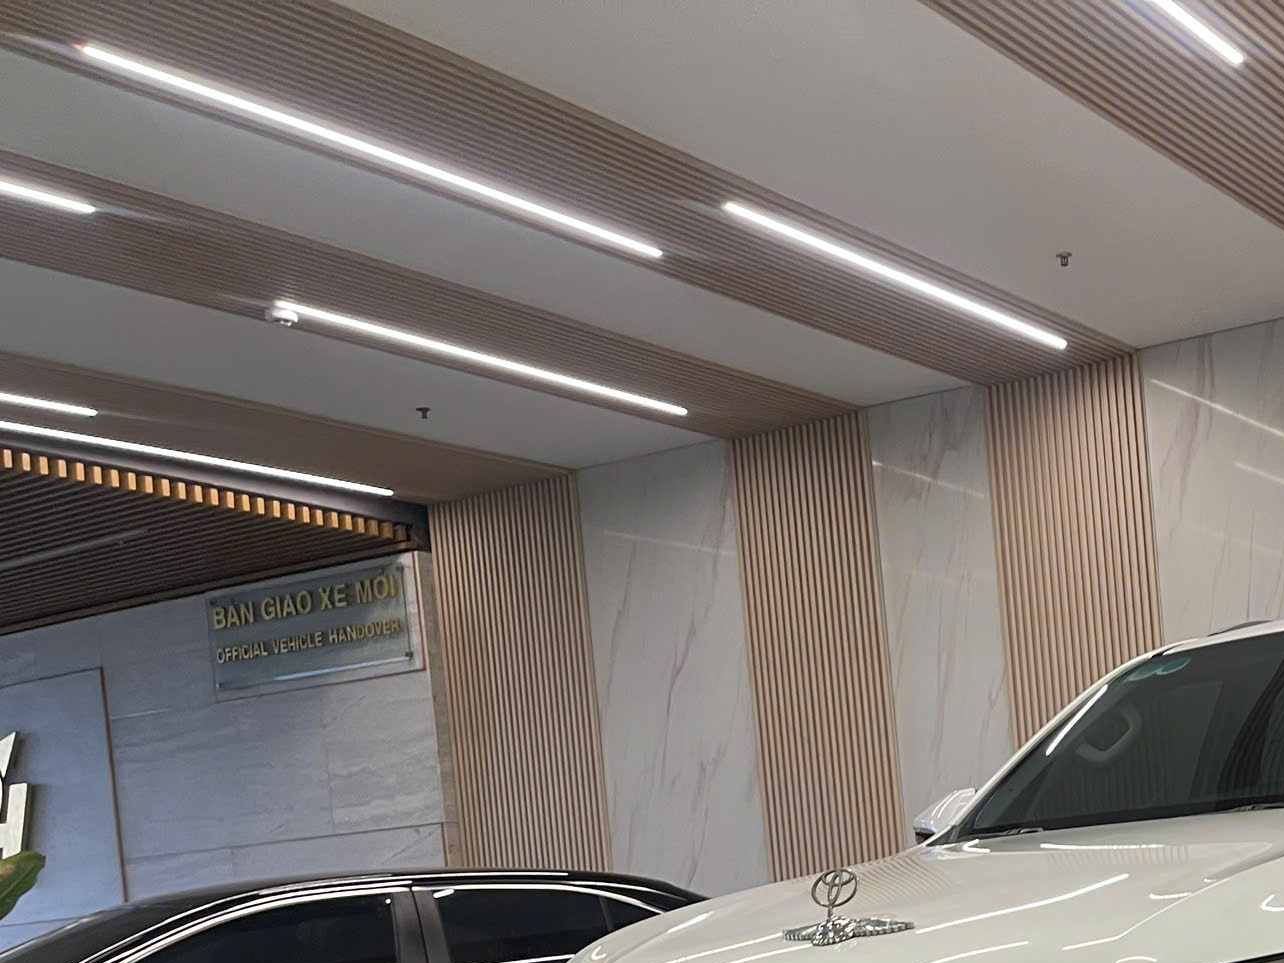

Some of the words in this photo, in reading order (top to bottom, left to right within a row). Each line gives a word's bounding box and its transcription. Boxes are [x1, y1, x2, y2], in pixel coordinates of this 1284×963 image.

[261, 590, 312, 621] GIAO
[318, 583, 347, 611] XE
[215, 641, 269, 665] OFFICIAL
[271, 631, 323, 655] VEHICLE
[328, 618, 403, 644] HANDOVER
